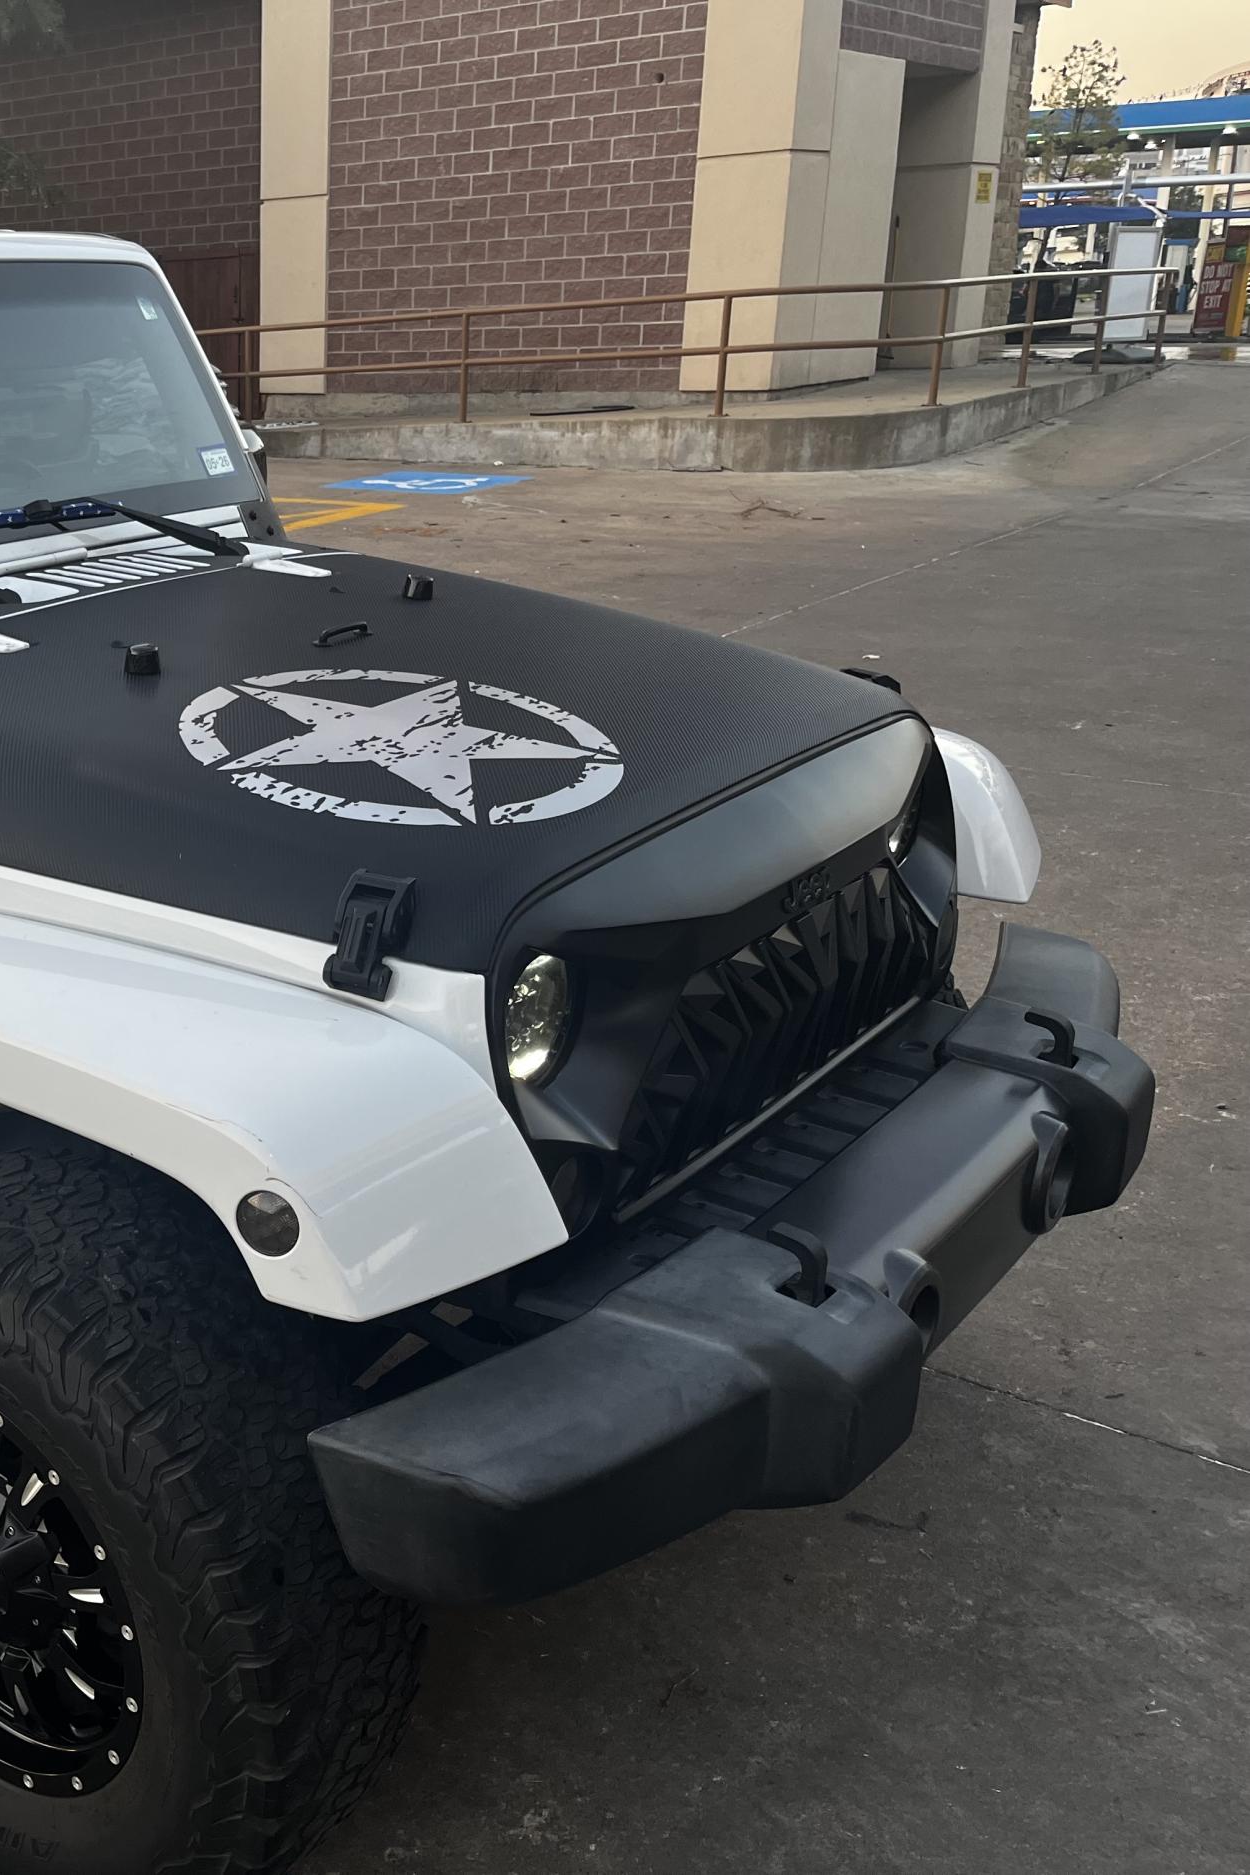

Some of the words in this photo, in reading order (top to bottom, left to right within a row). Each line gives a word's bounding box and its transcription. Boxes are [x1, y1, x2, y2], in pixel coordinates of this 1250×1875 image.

[1204, 265, 1215, 279] DO
[1217, 264, 1234, 277] NOT
[1200, 279, 1221, 294] STOP
[1222, 278, 1232, 292] AT
[1204, 295, 1222, 308] EXIT
